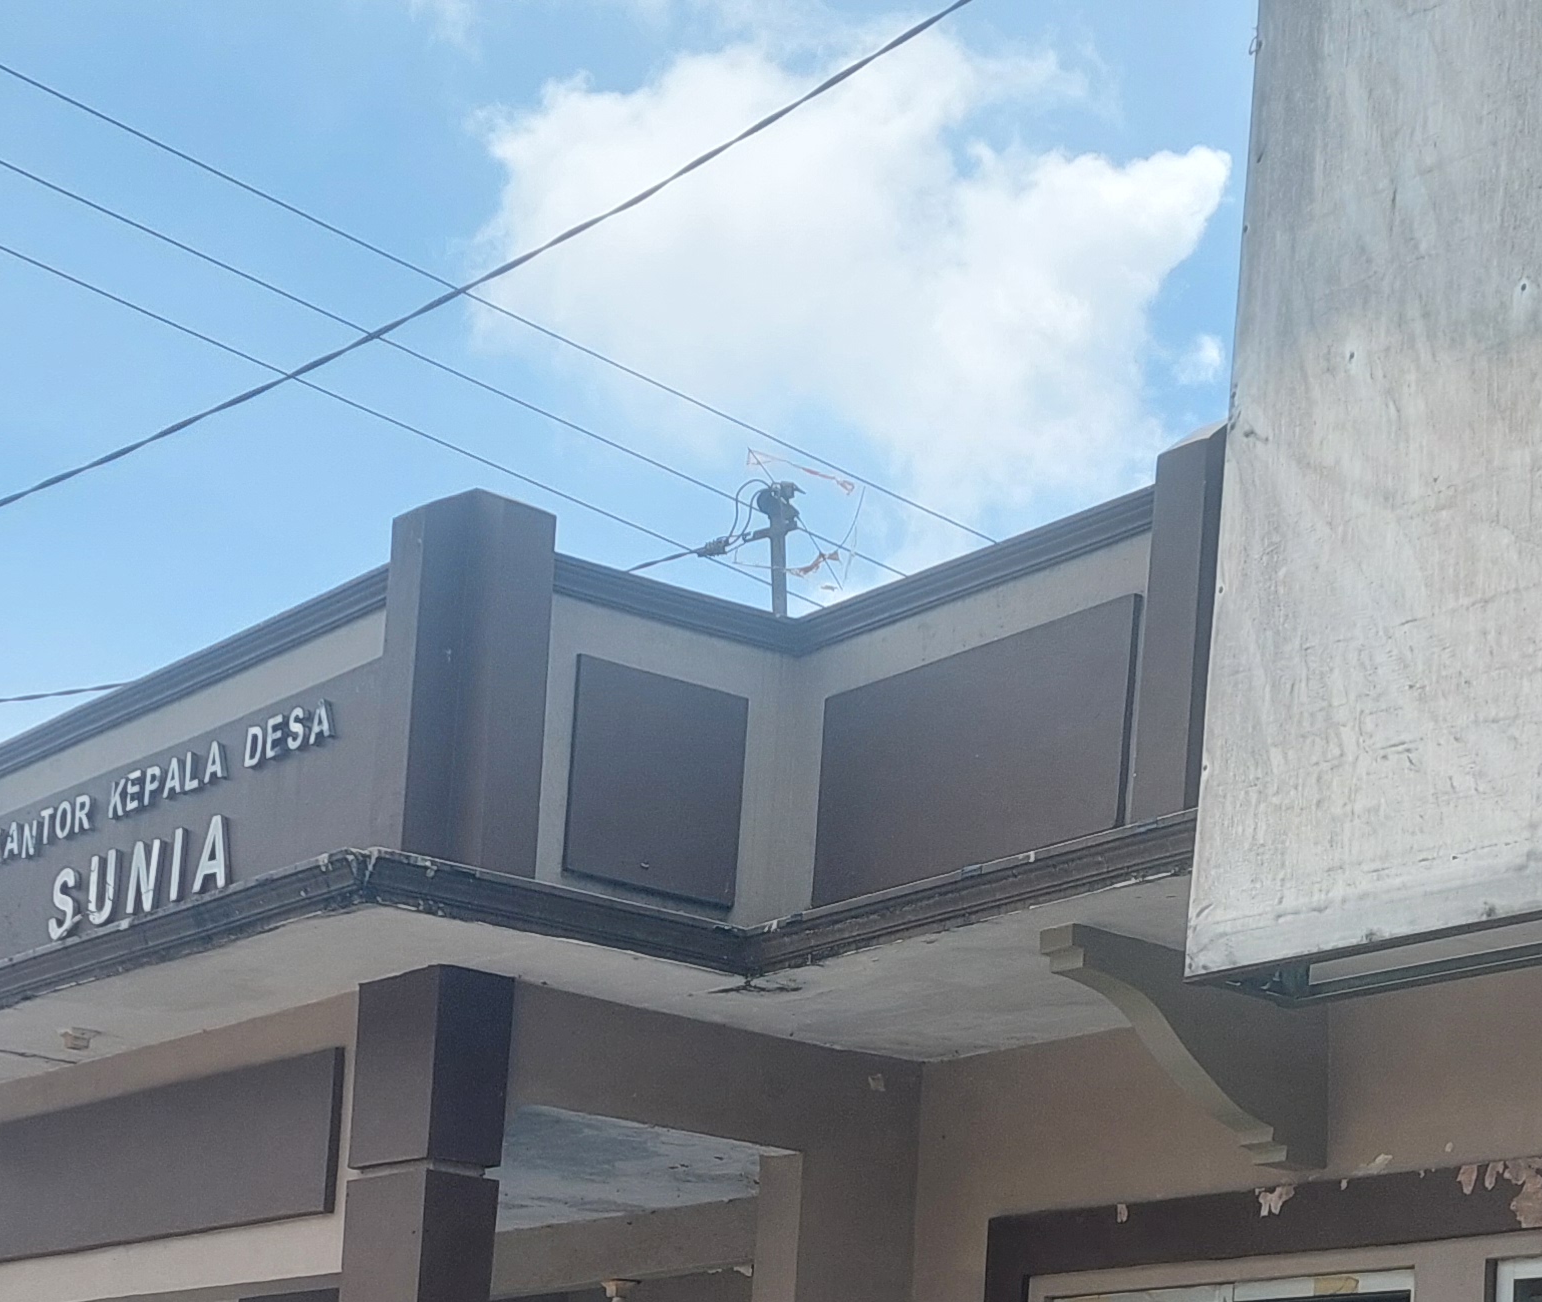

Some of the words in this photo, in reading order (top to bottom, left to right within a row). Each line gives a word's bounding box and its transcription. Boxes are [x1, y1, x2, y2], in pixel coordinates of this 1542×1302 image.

[107, 740, 228, 820] KEPALA
[243, 698, 336, 768] DESA
[47, 814, 230, 941] SUNIA
